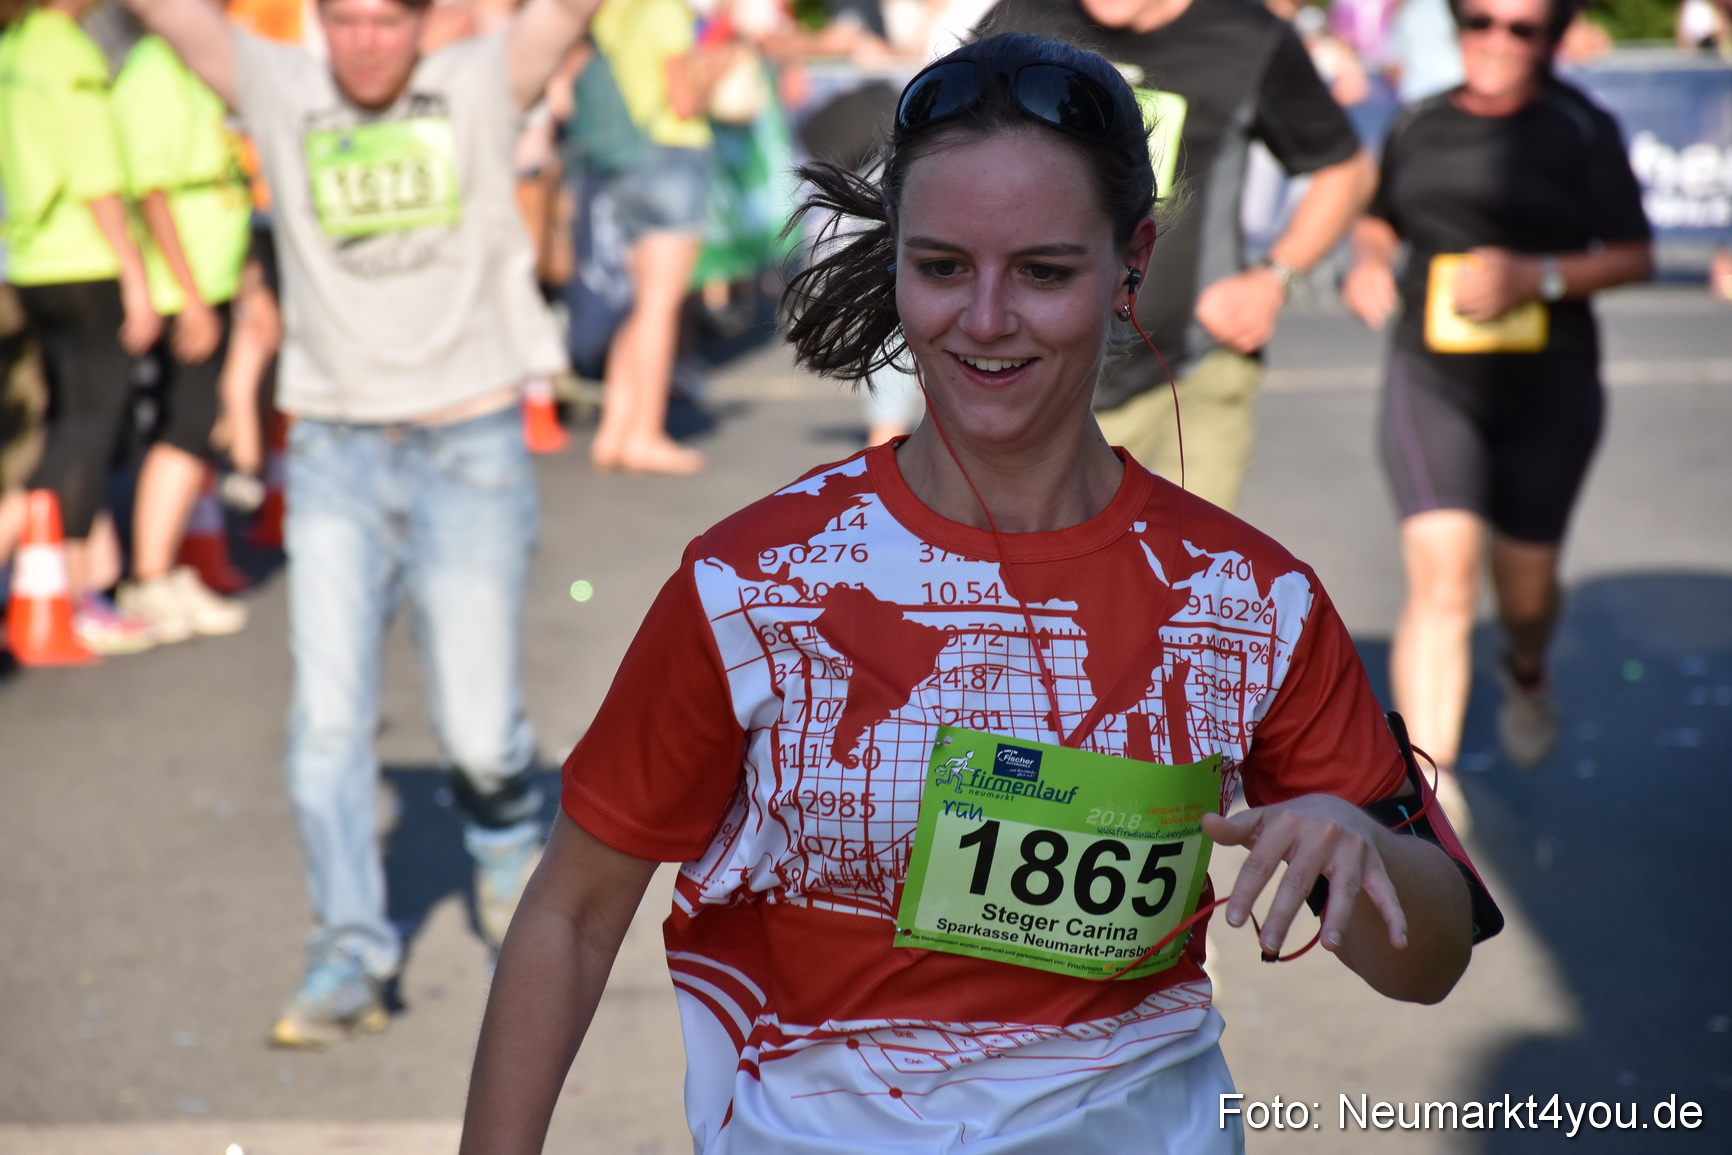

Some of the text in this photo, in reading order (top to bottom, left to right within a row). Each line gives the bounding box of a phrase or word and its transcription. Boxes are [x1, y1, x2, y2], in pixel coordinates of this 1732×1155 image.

[921, 581, 1002, 605] 10.54
[1004, 754, 1034, 766] Fischer
[968, 769, 1080, 804] firmenlauf
[968, 789, 1015, 802] neumarkt
[1086, 808, 1142, 829] 2018
[959, 820, 1184, 918] 1865
[936, 918, 1161, 958] Sparkasse Neumarkt-Parsbeg
[981, 903, 1138, 941] Steger Carina
[920, 935, 959, 946] Startnummern
[980, 945, 1004, 954] gedruckt
[1016, 952, 1053, 963] personalisiert
[1067, 962, 1103, 973] Frischmann
